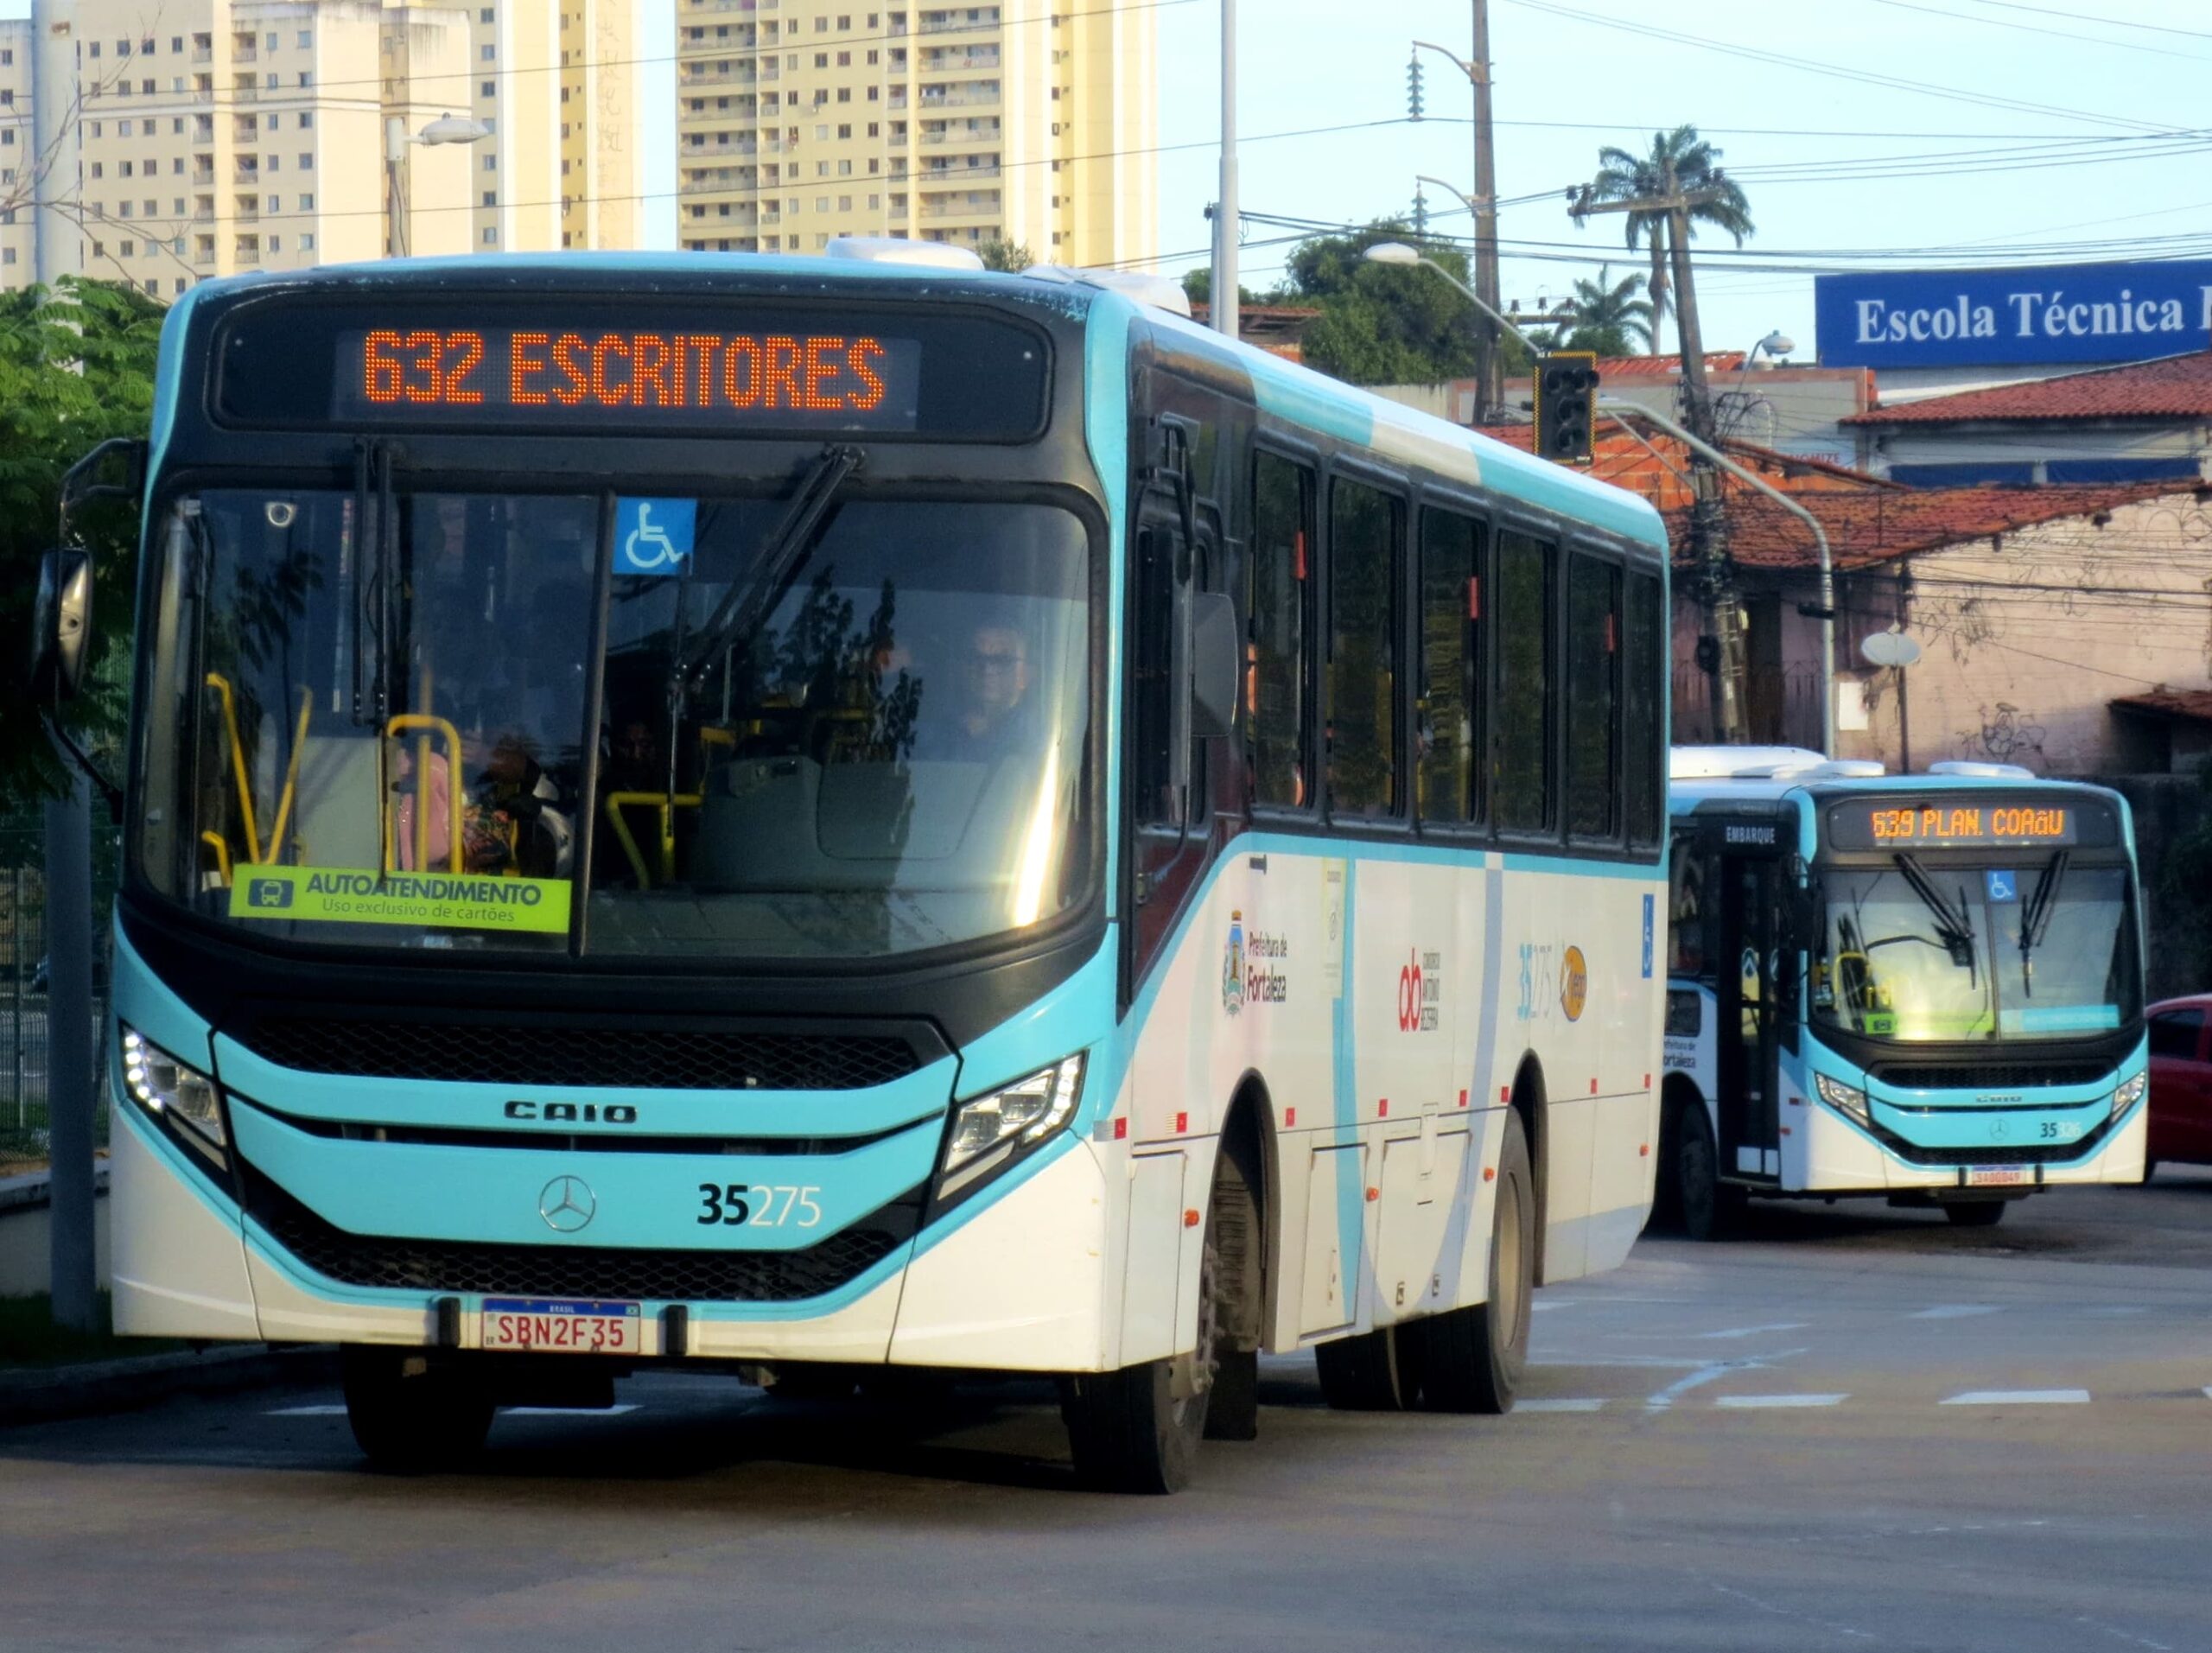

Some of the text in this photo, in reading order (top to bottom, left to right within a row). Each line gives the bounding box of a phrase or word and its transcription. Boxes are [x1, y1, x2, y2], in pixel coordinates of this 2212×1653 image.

[1855, 295, 1997, 343] Escola
[2008, 289, 2183, 338] Técnica
[364, 331, 886, 410] 632 ESCRITORES
[1726, 826, 1776, 844] EMBARQUE
[306, 873, 542, 906] AUTOATENDIMENTO
[322, 898, 516, 922] Uso exclusivo de cartões
[1246, 963, 1287, 1002] Fortaleza
[1663, 1052, 1696, 1068] ortaleza
[504, 1101, 638, 1123] CAIO
[696, 1184, 822, 1227] 35275
[549, 1305, 575, 1313] BRASIL
[499, 1315, 624, 1347] SBN2F35
